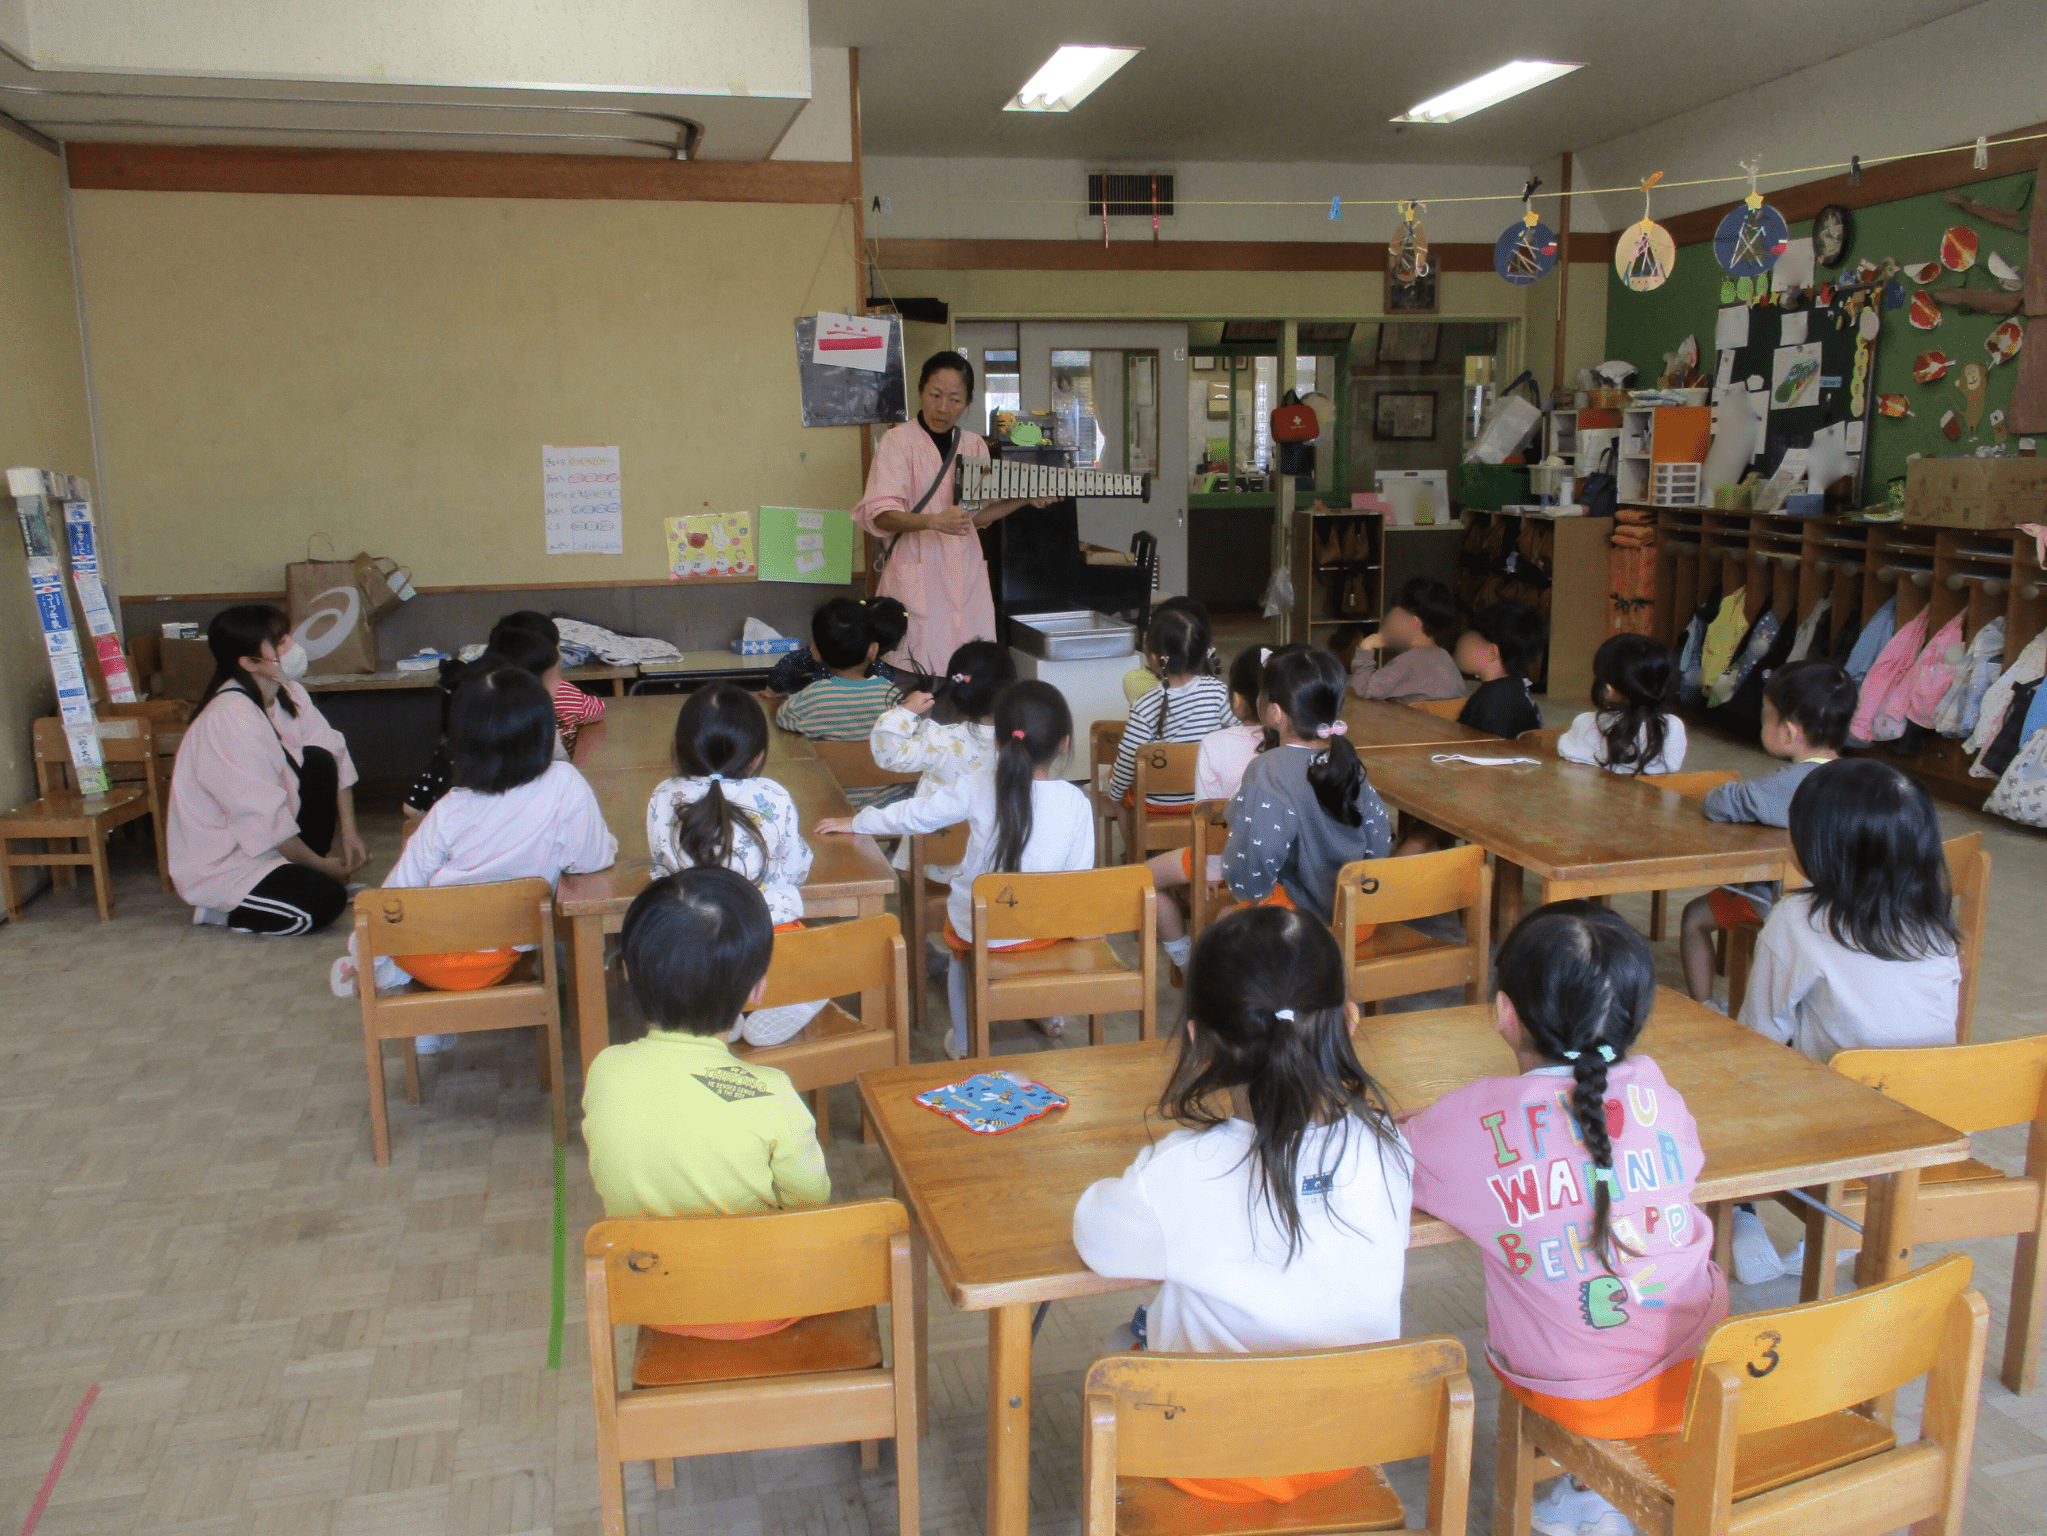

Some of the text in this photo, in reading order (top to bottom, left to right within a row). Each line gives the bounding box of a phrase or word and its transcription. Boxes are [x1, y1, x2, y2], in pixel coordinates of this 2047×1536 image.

[1151, 748, 1167, 769] 8
[1480, 1101, 1552, 1169] IF
[1746, 1330, 1782, 1378] 3
